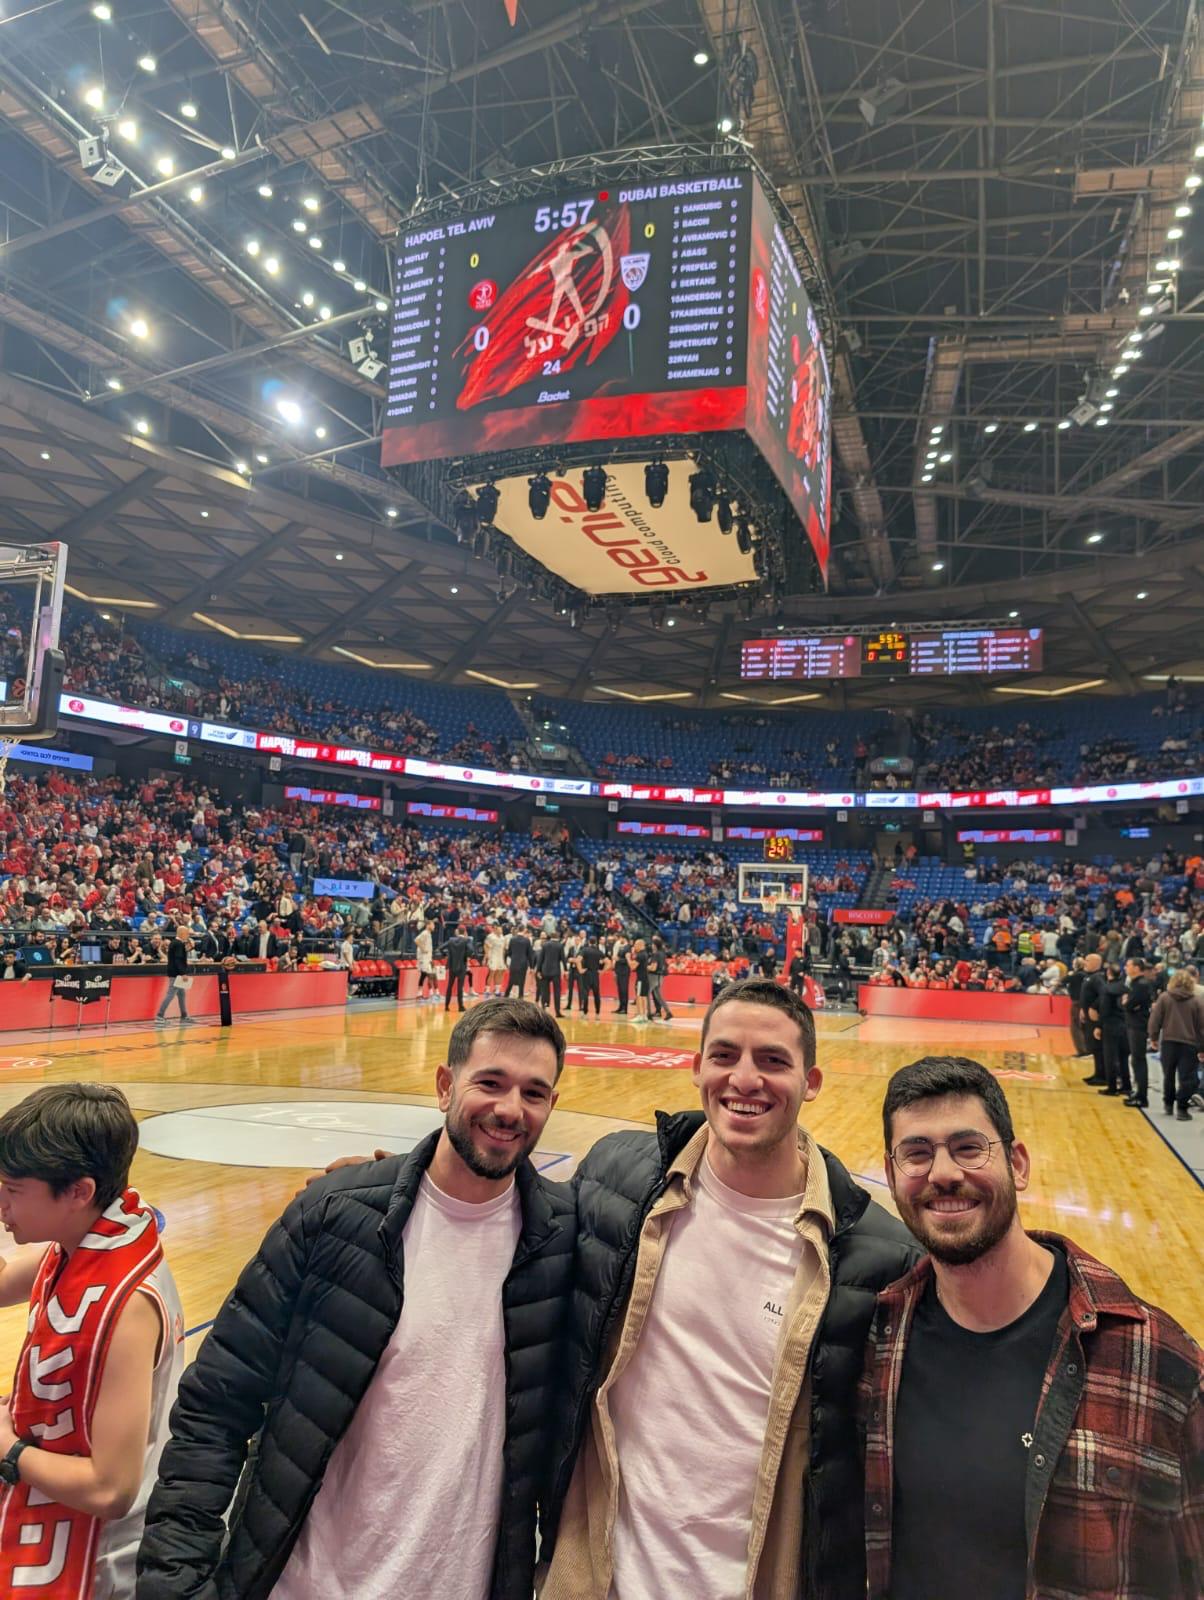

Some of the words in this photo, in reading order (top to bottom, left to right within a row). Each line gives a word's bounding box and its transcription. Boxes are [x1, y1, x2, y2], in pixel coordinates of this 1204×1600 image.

[619, 187, 657, 203] DUBAI
[660, 177, 742, 197] BASKETBALL
[534, 199, 595, 232] 5:57
[405, 228, 445, 248] HAPOEL
[447, 223, 466, 237] TEL
[468, 215, 495, 232] AVIV
[644, 223, 655, 238] 0
[470, 253, 479, 268] 0
[672, 266, 678, 274] 7
[623, 303, 640, 330] 0
[474, 326, 489, 351] 0
[542, 360, 561, 375] 24
[605, 475, 656, 538] computing
[191, 725, 198, 734] 9
[768, 846, 785, 858] 24
[763, 1301, 784, 1316] ALL
[11, 1285, 107, 1588] הועל
